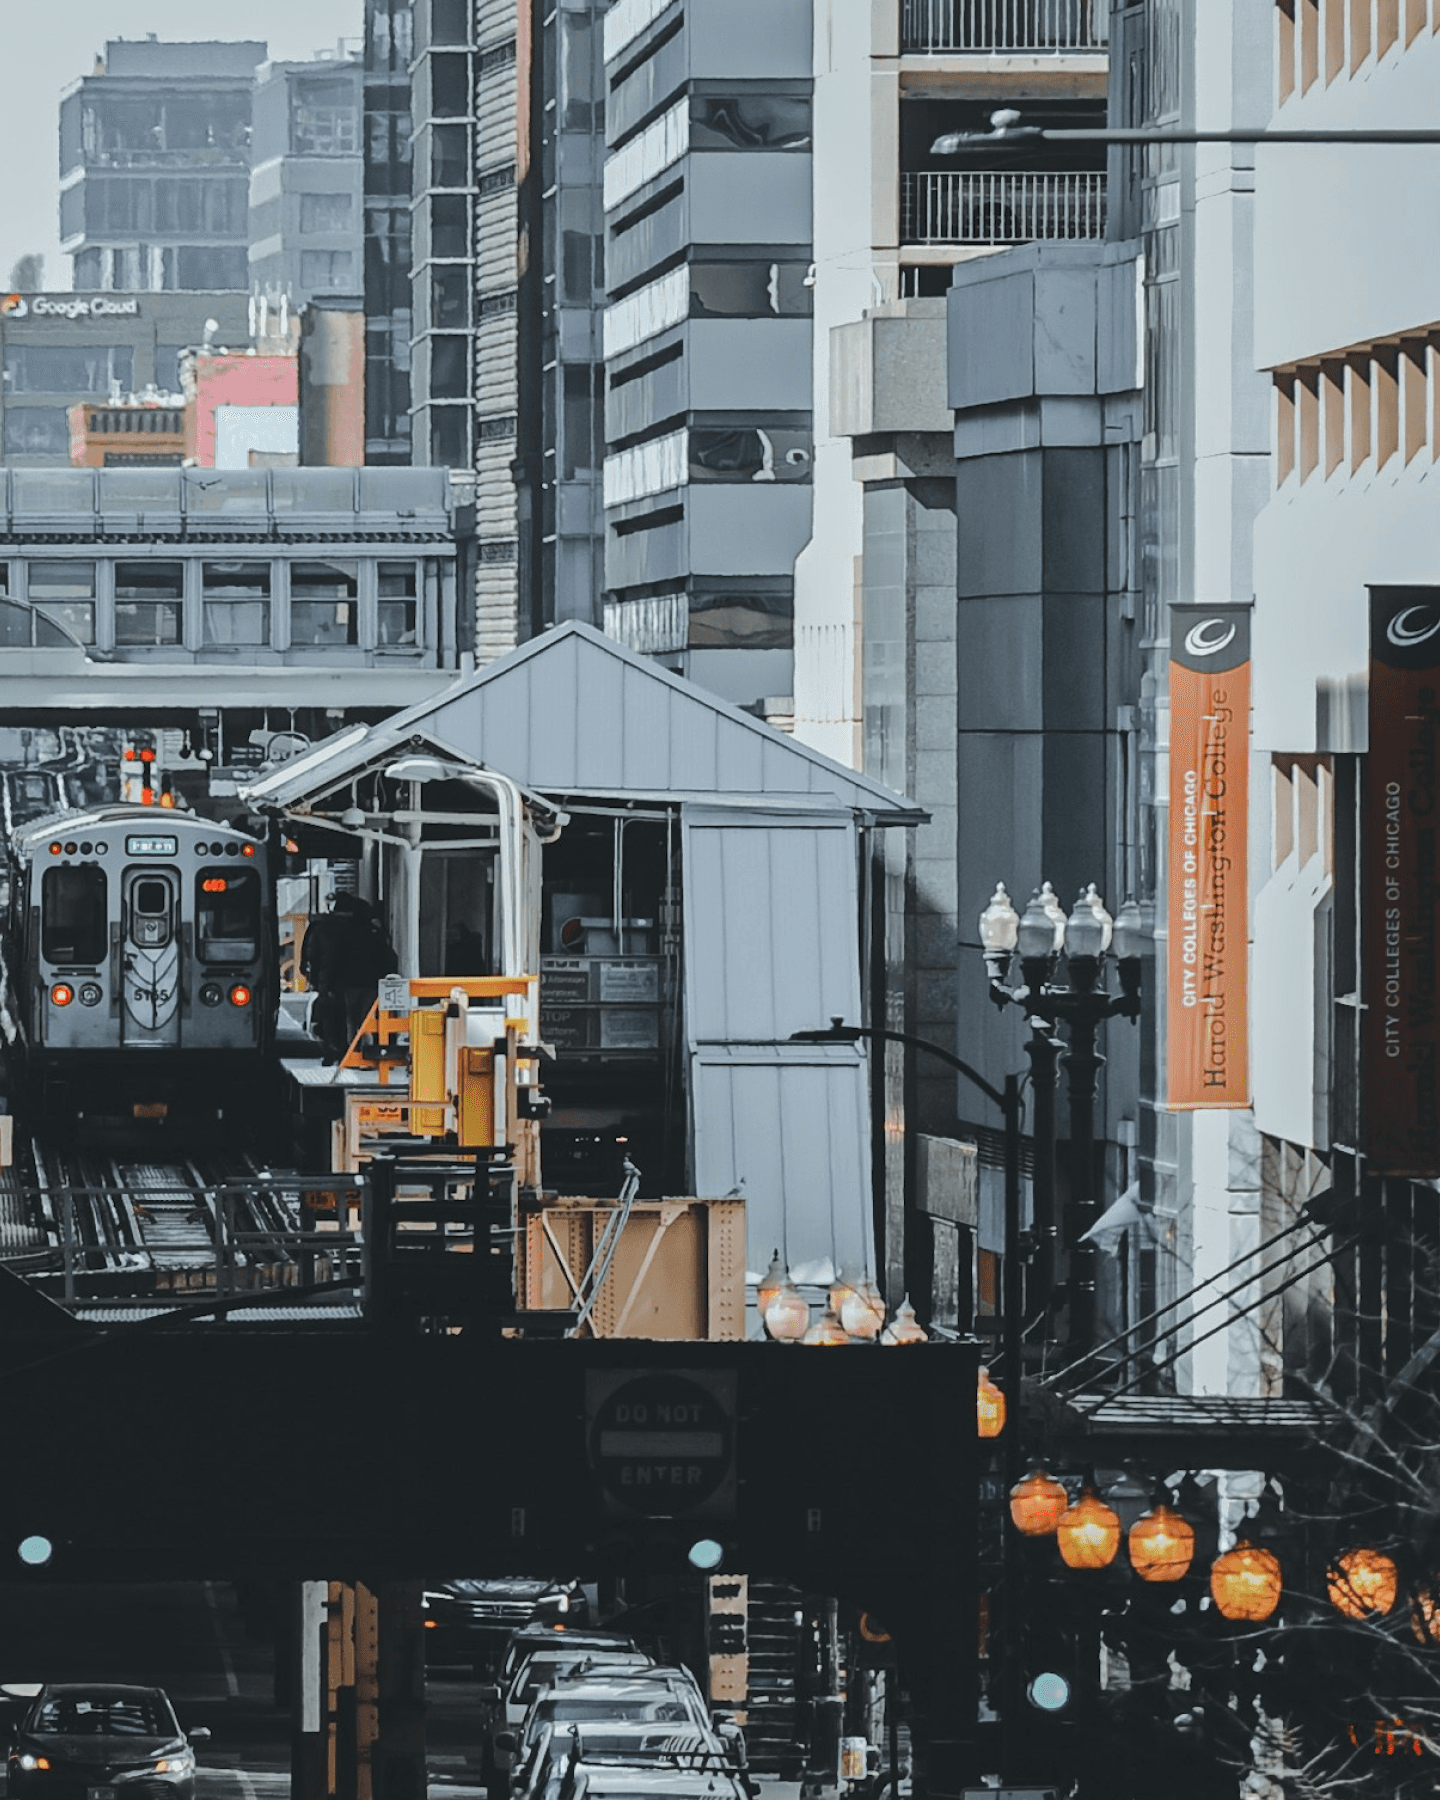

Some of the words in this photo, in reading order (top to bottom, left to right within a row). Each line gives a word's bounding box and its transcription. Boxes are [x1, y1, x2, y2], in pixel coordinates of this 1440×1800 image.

[32, 296, 90, 318] Google
[90, 297, 138, 314] Cloud
[1204, 689, 1234, 799] College
[1184, 770, 1197, 846] CHICAGO
[1385, 781, 1401, 869] CHICAGO
[1184, 850, 1197, 873] OF
[1385, 875, 1401, 900] OF
[1183, 878, 1197, 965] COLLEGES
[1204, 809, 1231, 981] Washington
[1385, 907, 1401, 1007] COLLEGES
[1183, 969, 1197, 1008] CITY
[1203, 992, 1226, 1089] Harold
[1385, 1014, 1401, 1057] CITY
[615, 1404, 648, 1423] DO
[656, 1403, 703, 1423] NOT
[620, 1465, 703, 1485] ENTER
